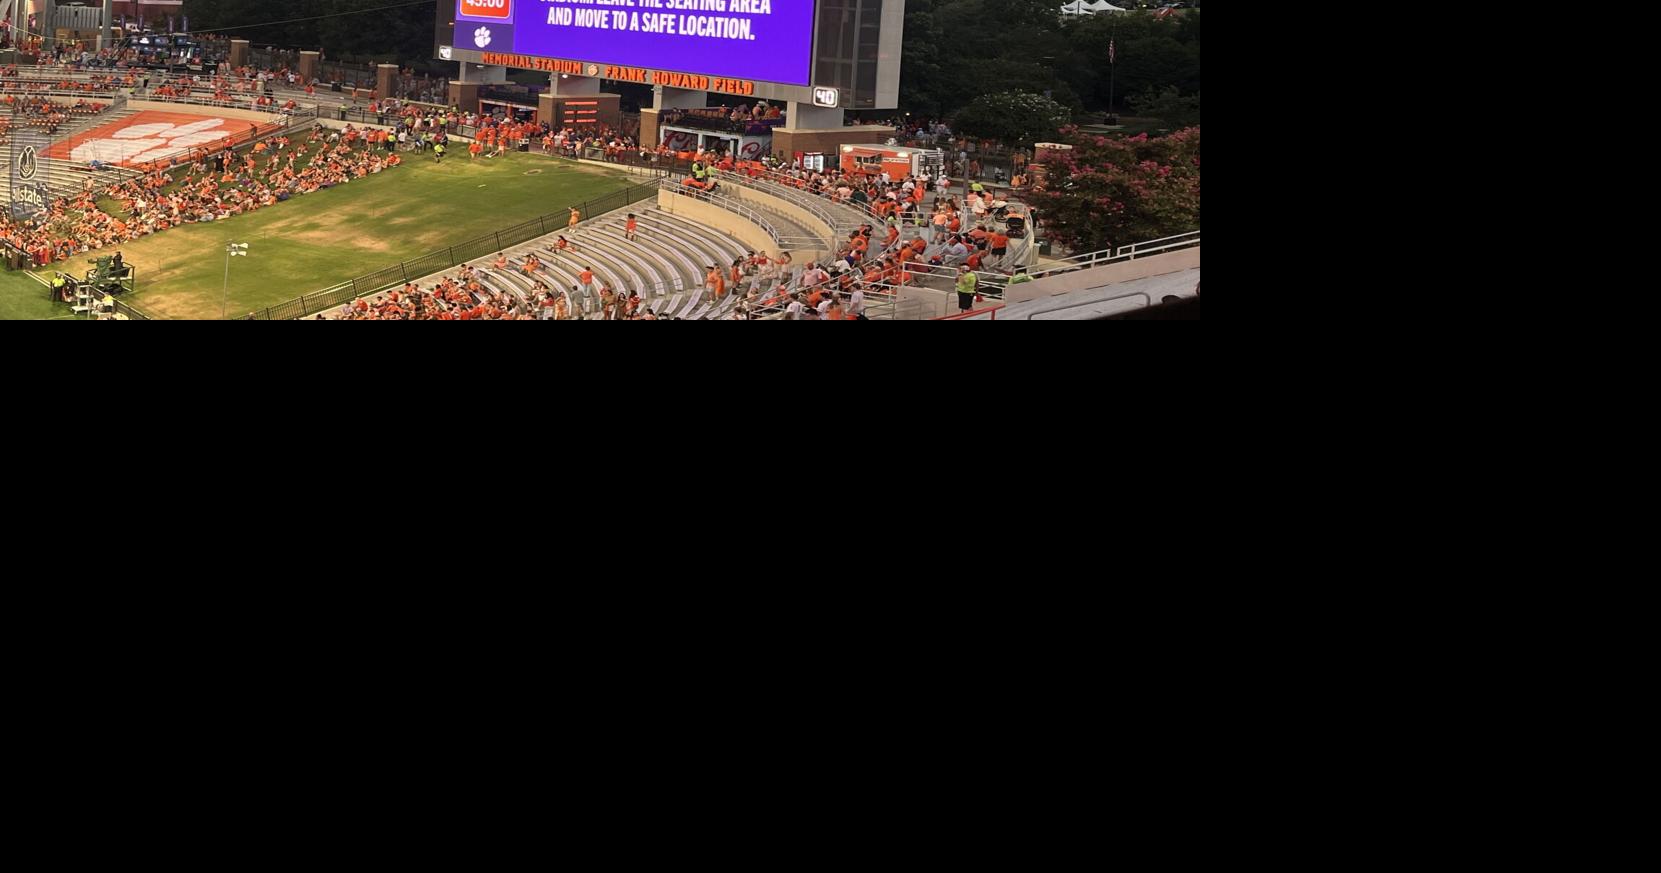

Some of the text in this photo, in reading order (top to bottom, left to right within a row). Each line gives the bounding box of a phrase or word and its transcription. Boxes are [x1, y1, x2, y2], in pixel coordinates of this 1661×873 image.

[729, 0, 771, 14] AREA
[547, 6, 756, 40] AND MOVE TO A SAFE LOCATION.
[481, 51, 754, 95] MEMORIAL STADIUM FRANK HOWARD FIELD
[816, 90, 835, 105] 40
